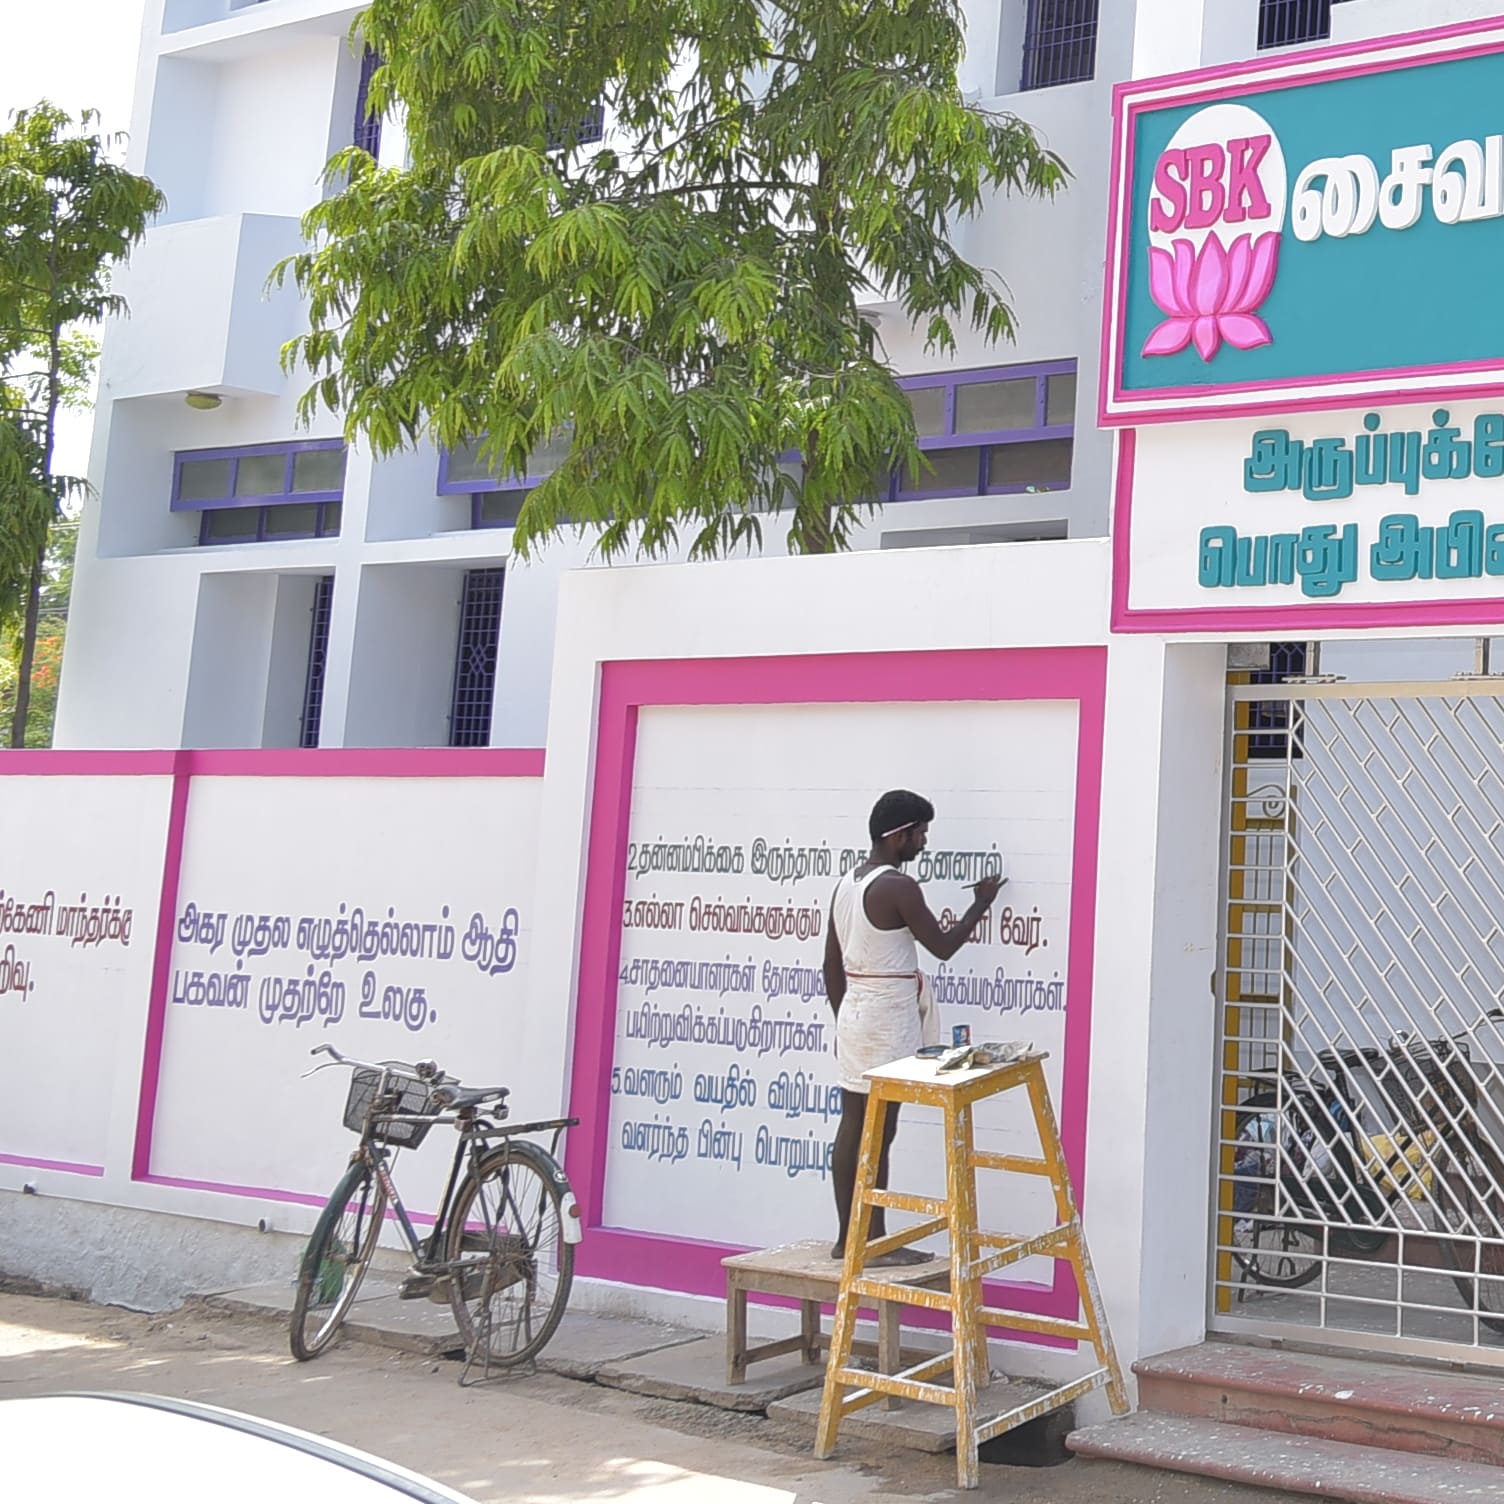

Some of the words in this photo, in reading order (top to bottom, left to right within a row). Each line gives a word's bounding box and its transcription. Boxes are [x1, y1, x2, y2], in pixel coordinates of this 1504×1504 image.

[1150, 134, 1273, 234] SBK
[1198, 522, 1359, 598] பொது
[750, 837, 832, 886] இருந்தால்
[176, 902, 228, 956] அகர
[231, 913, 291, 958] முதல
[296, 902, 455, 967] எழுத்தெல்லாம்
[462, 907, 520, 977] ஆதி
[171, 958, 251, 1009] பகவன்
[694, 1063, 757, 1114] வயதில்
[621, 1114, 690, 1165] வளர்ந்த
[697, 1119, 743, 1172] பின்பு
